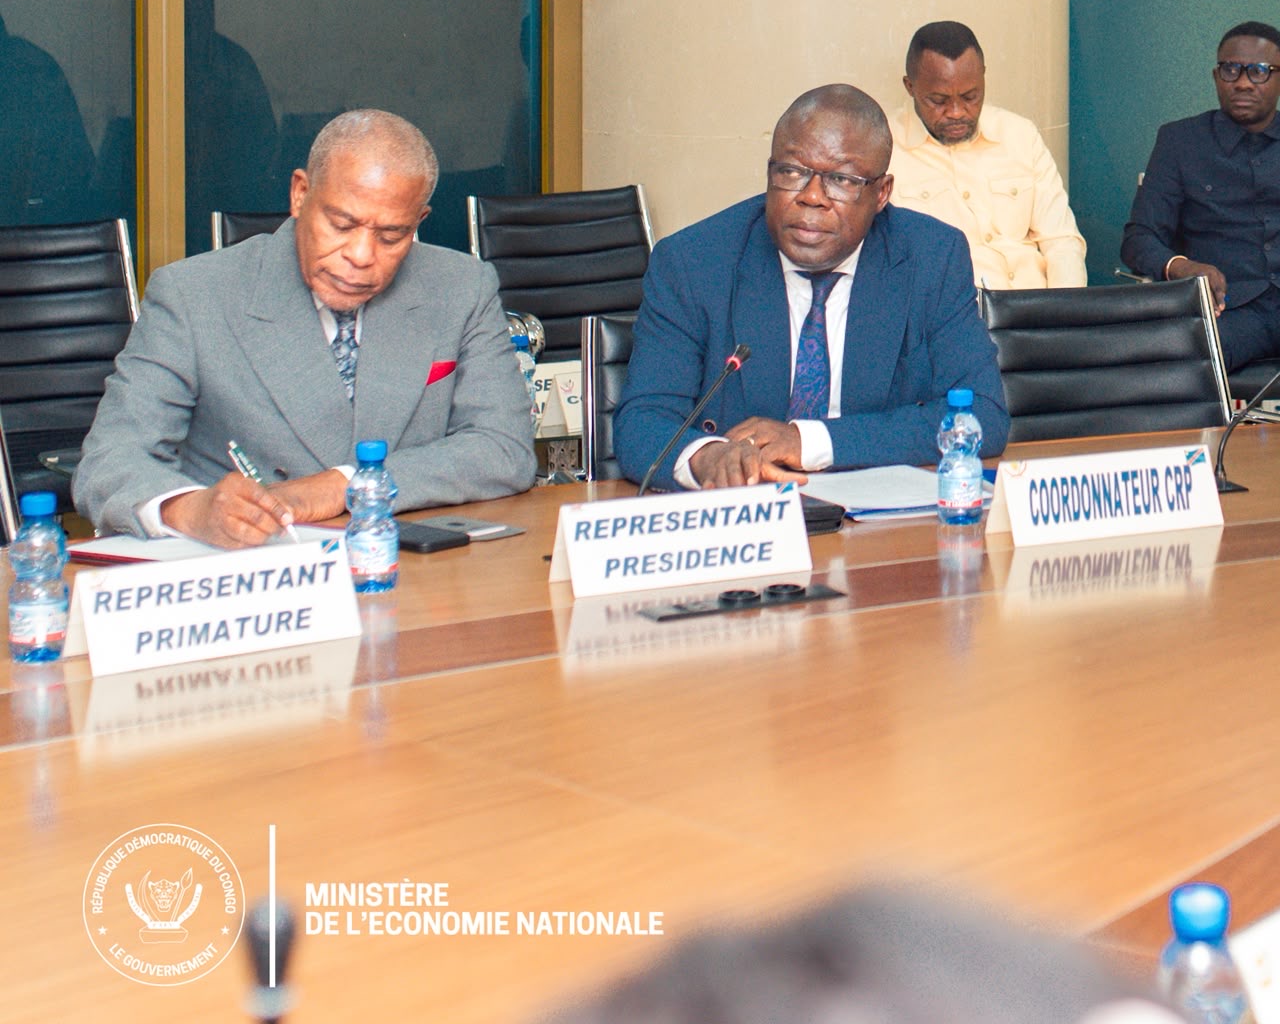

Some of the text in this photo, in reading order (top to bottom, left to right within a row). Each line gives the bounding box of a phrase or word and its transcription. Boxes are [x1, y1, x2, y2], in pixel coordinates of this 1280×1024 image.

[1029, 468, 1162, 526] COORDONNATEUR
[1165, 464, 1192, 511] CRP
[574, 500, 791, 542] REPRESENTANT
[604, 541, 774, 579] PRESIDENCE
[93, 561, 337, 615] REPRESENTANT
[135, 607, 313, 655] PRIMATURE
